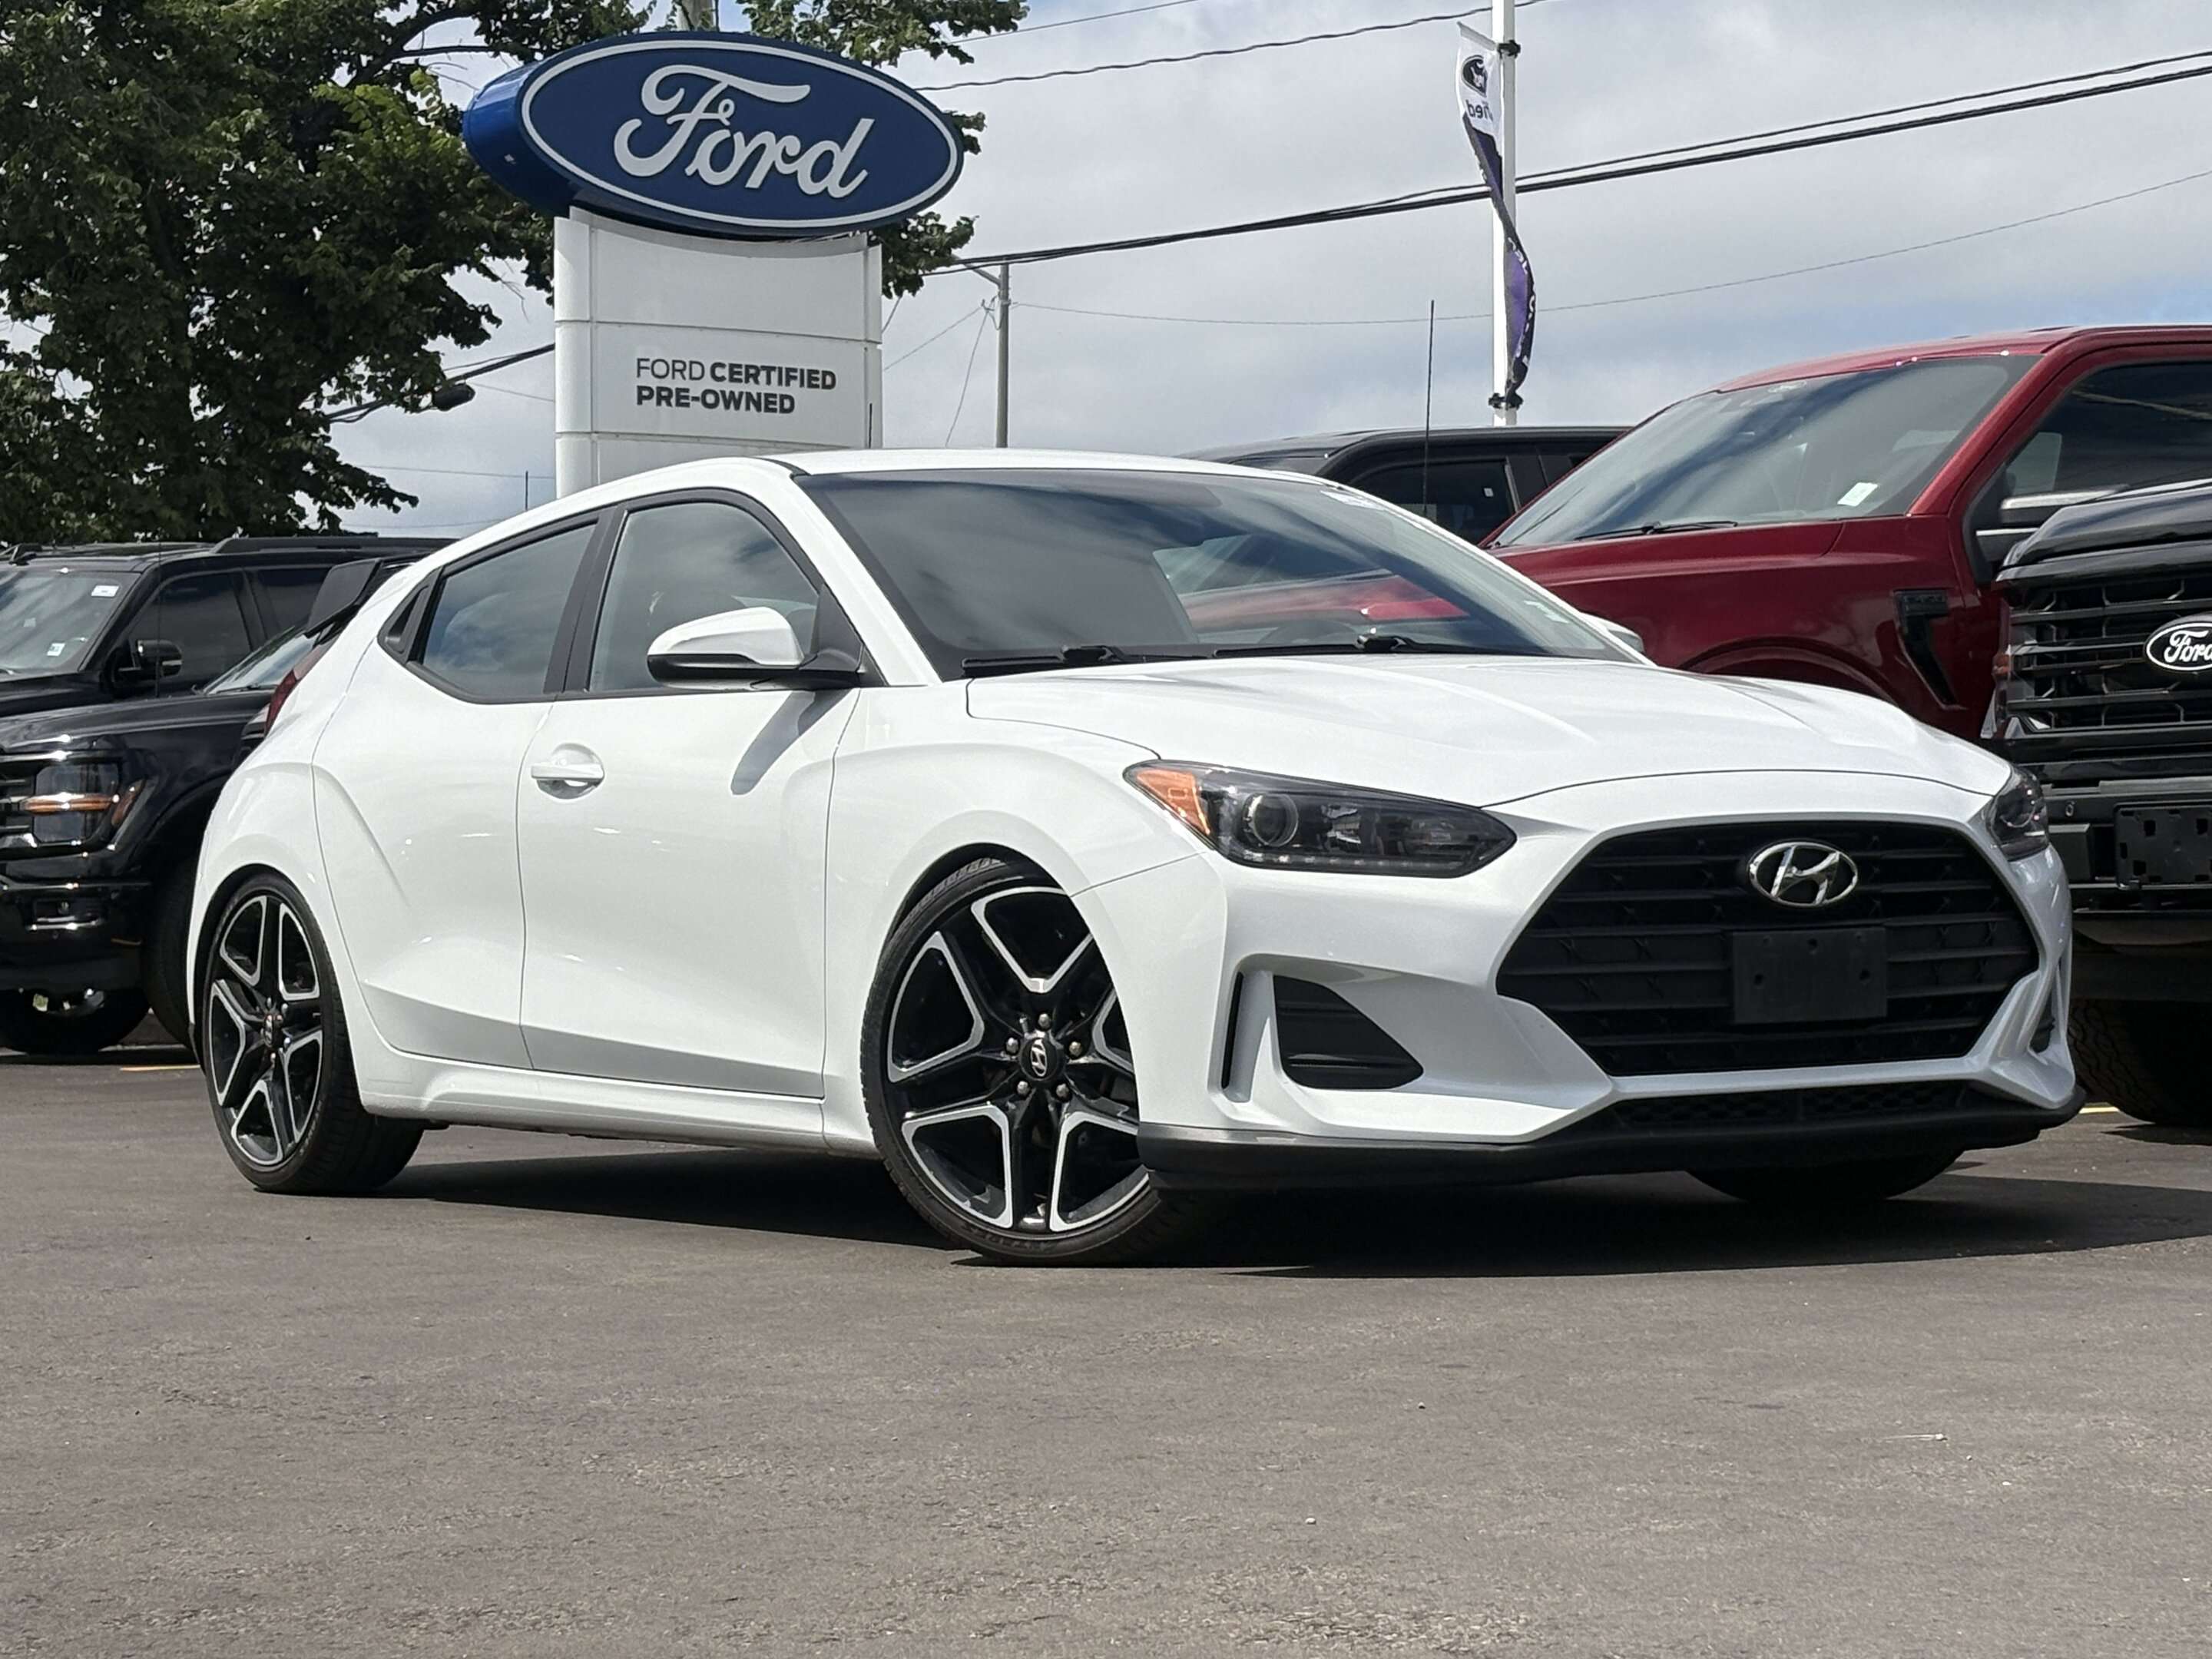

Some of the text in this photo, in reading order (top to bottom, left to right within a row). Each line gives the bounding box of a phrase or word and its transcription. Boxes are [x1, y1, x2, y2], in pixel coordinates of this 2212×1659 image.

[614, 64, 876, 199] Ford
[636, 357, 836, 390] FORD CERTIFIED
[636, 385, 796, 414] PRE-OWNED
